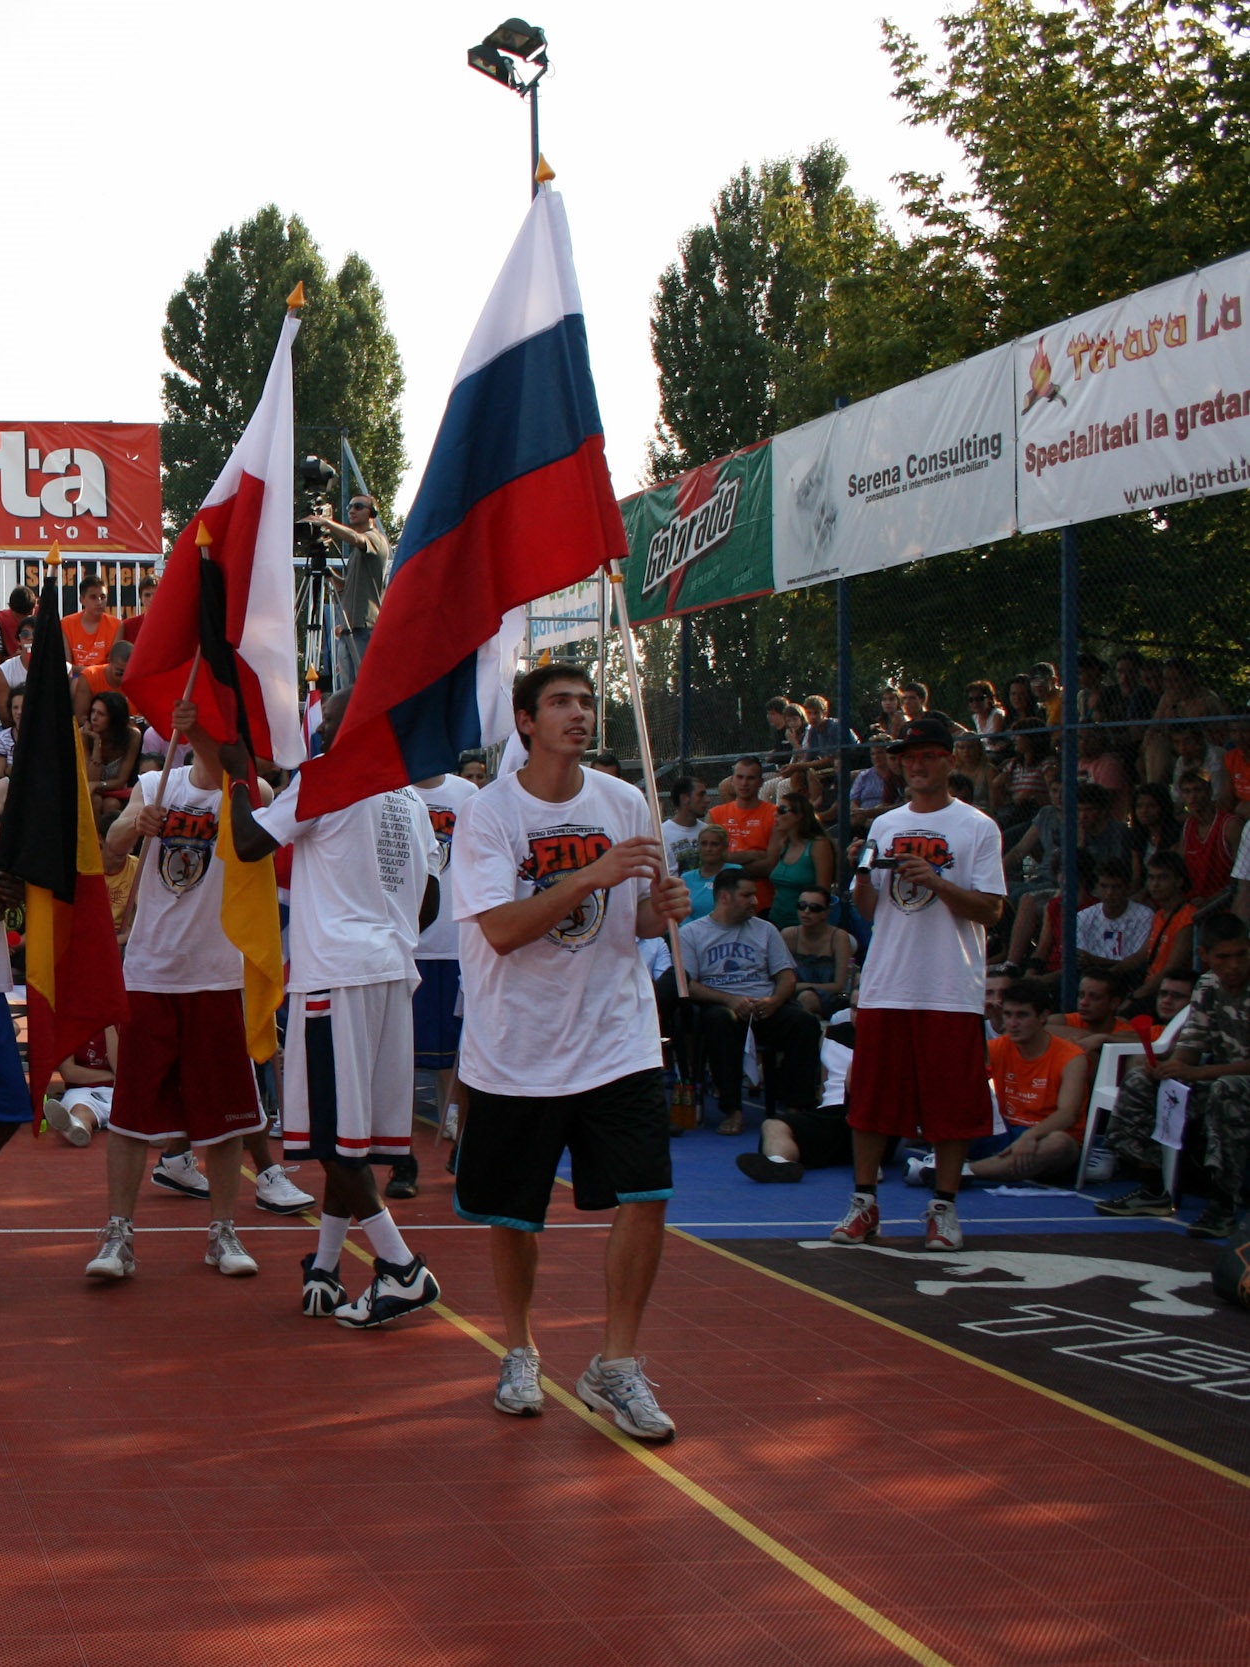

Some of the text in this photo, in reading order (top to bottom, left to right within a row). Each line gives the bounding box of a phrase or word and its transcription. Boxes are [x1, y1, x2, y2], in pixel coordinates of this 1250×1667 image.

[1066, 288, 1242, 381] Terasa La
[848, 432, 1002, 498] Serena Consulting
[1024, 412, 1139, 478] Specialitati
[1145, 408, 1168, 441] la
[908, 471, 951, 491] intermediere
[642, 480, 737, 593] Gatorade
[707, 942, 756, 967] DUKE
